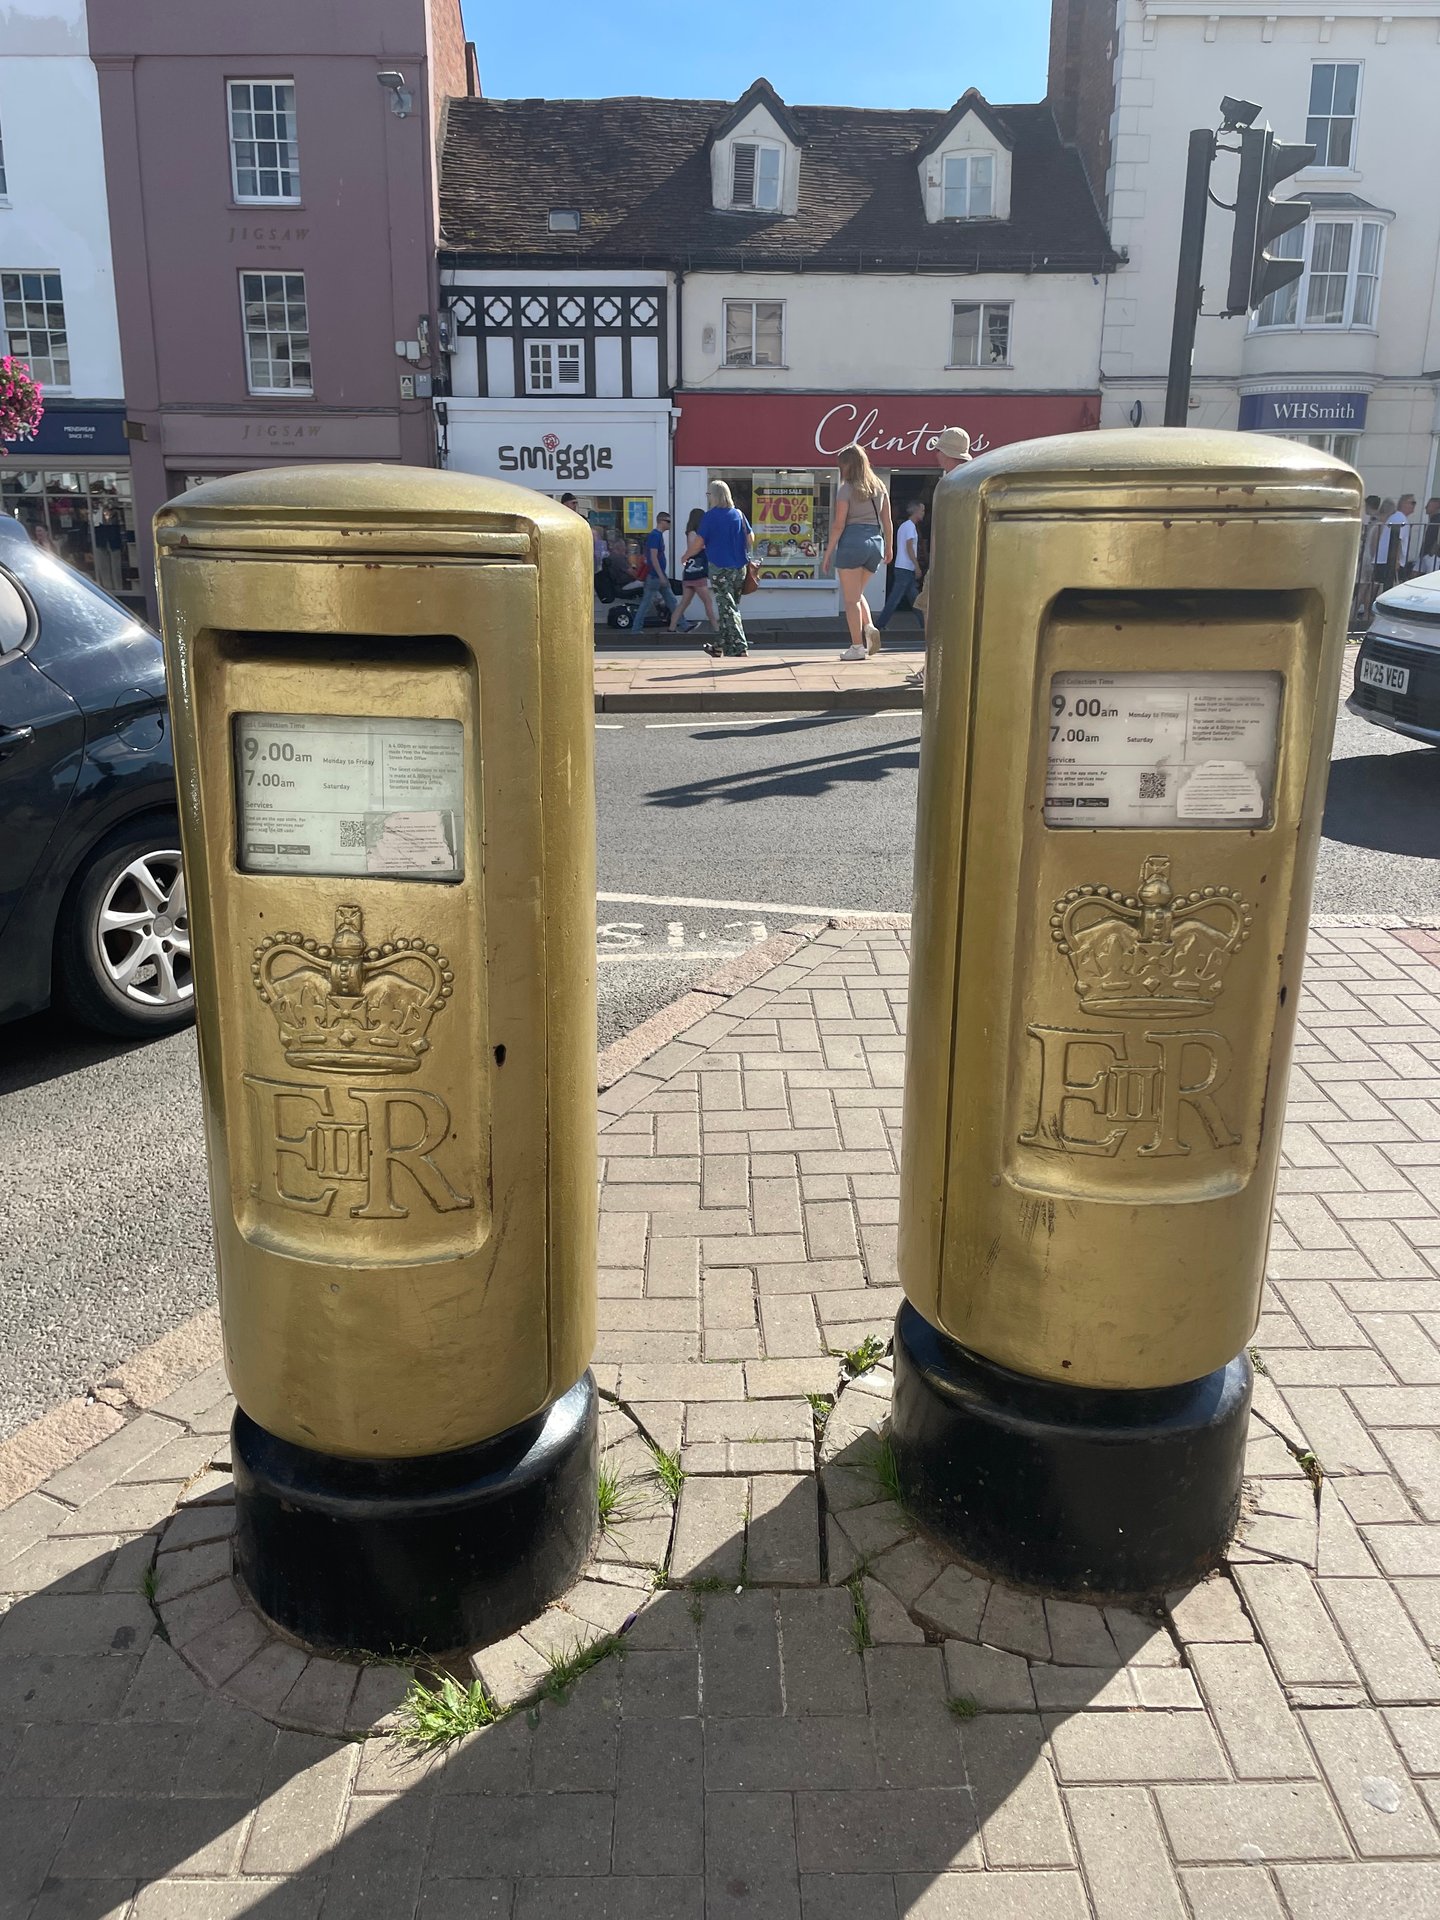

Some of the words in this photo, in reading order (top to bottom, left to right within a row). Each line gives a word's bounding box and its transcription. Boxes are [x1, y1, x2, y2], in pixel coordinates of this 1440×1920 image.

[228, 227, 310, 243] JIGSAW
[1273, 403, 1355, 419] WHSmith
[242, 425, 321, 440] JIGSAW
[814, 403, 990, 456] Clintos
[757, 496, 809, 522] 70%
[791, 513, 808, 522] OFF
[1051, 694, 1118, 717] 9.00am
[1128, 711, 1152, 719] Monday
[1160, 711, 1179, 719] Friday
[1050, 725, 1100, 742] 7.00am
[1127, 736, 1154, 744] Saturday
[244, 737, 313, 762] 9.00am
[323, 757, 346, 766] Monday
[347, 758, 354, 766] to
[355, 758, 375, 767] Friday
[1047, 756, 1076, 764] Services
[244, 769, 296, 788] 7.00am
[323, 782, 351, 791] Saturday
[245, 800, 273, 809] Services
